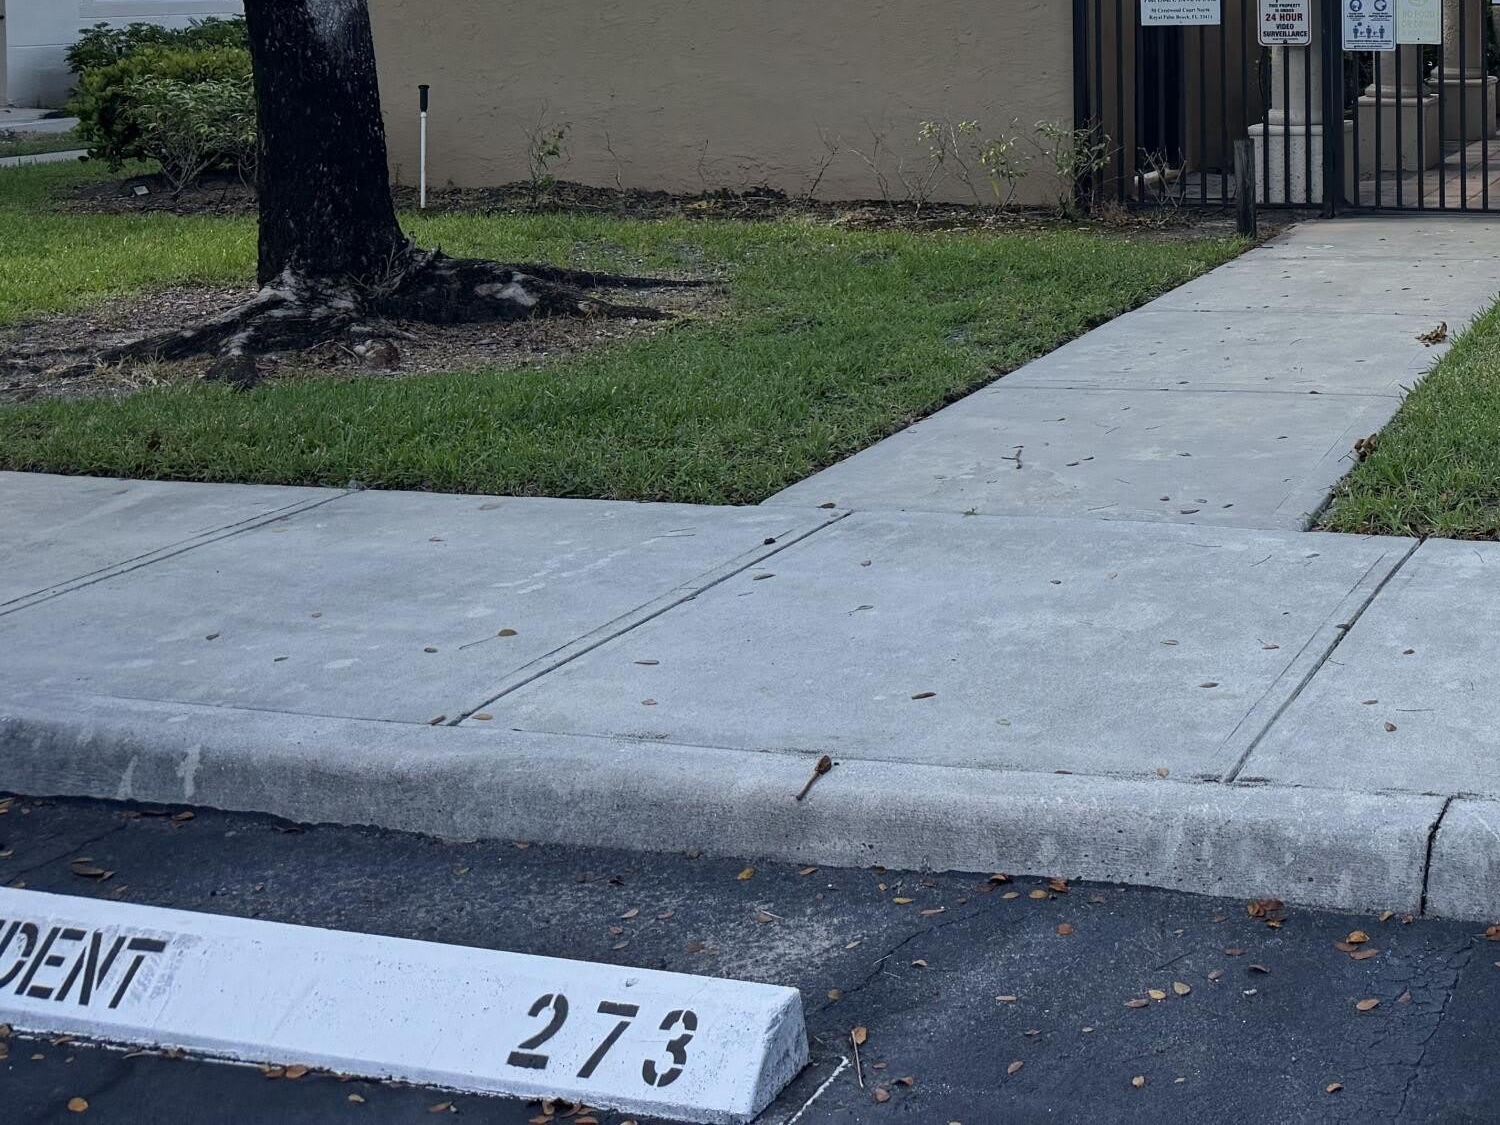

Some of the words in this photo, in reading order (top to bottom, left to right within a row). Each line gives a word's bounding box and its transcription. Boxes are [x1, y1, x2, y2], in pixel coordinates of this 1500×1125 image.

[1263, 30, 1308, 38] SURVEILLANCE
[1265, 13, 1276, 22] 24
[1280, 13, 1303, 22] HOUR
[0, 919, 167, 1010] DENT
[506, 992, 698, 1088] 273
